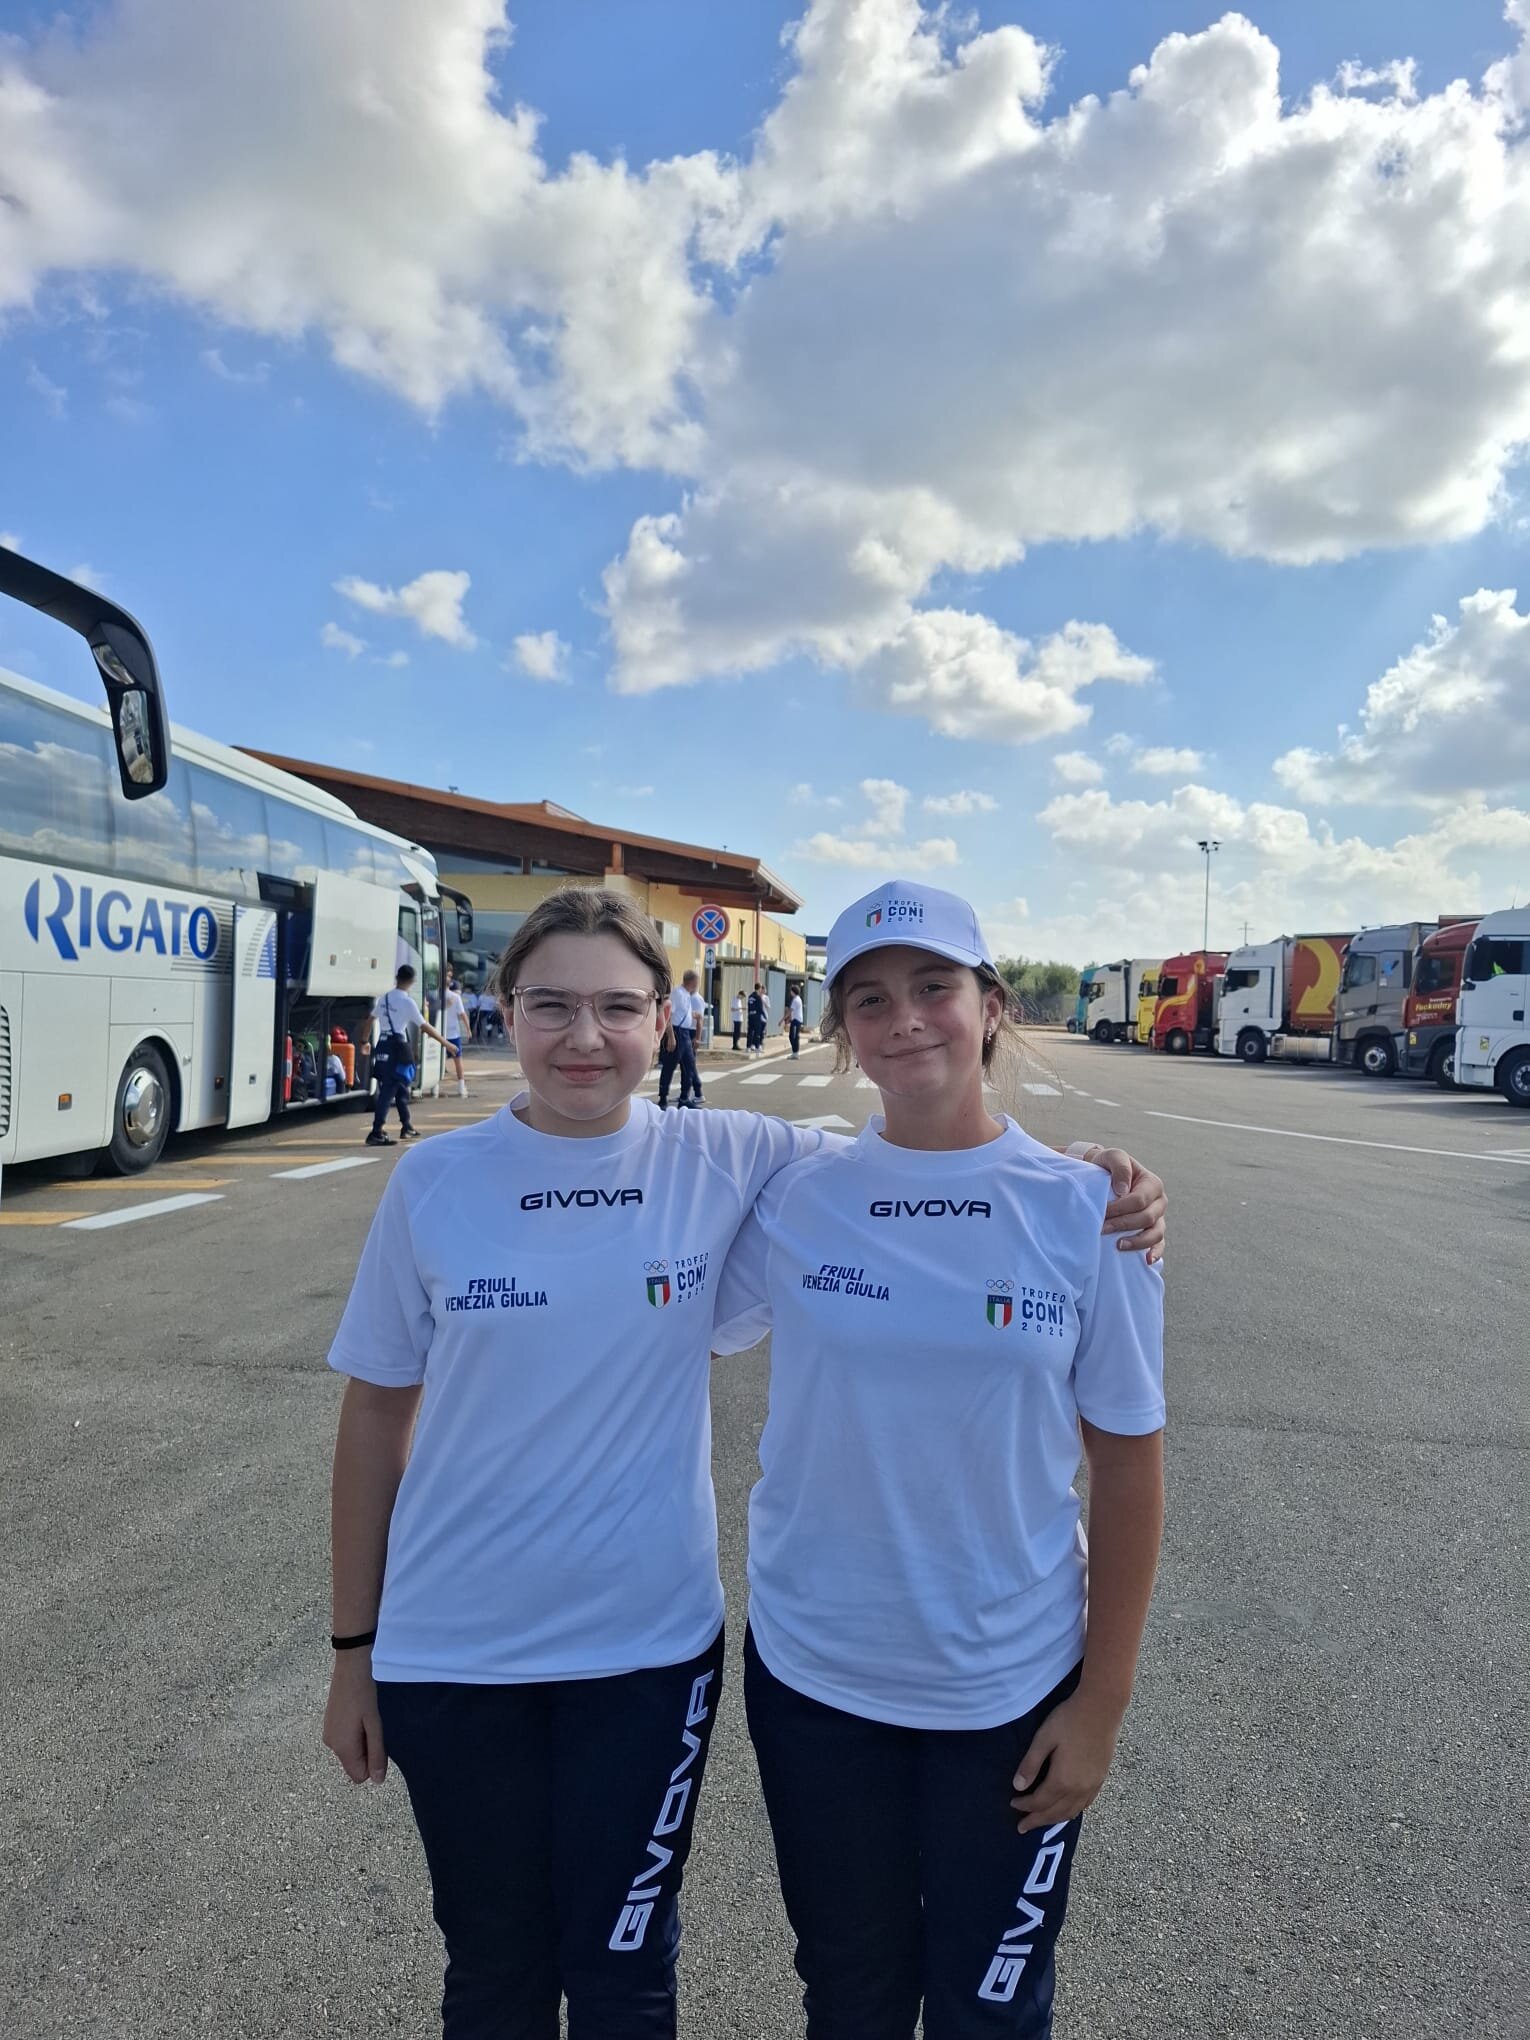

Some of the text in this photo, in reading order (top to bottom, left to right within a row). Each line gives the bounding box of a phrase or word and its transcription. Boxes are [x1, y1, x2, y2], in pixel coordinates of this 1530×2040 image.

[24, 873, 220, 961] RIGATO
[888, 906, 924, 917] CONI
[520, 1188, 643, 1211] GIVOVA
[870, 1200, 991, 1218] GIVOVA
[675, 1252, 709, 1269] TROFEO
[677, 1263, 707, 1291] CONI
[819, 1264, 864, 1281] FRIULI
[468, 1277, 516, 1294] FRIULI
[802, 1274, 890, 1301] VENEZIA GIULIA
[1021, 1286, 1066, 1303] TROFEO
[445, 1291, 548, 1311] VENEZIA GIULIA
[1021, 1299, 1064, 1325] CONI
[608, 1669, 714, 1951] GIVOVA
[977, 1819, 1070, 2003] GIVO
